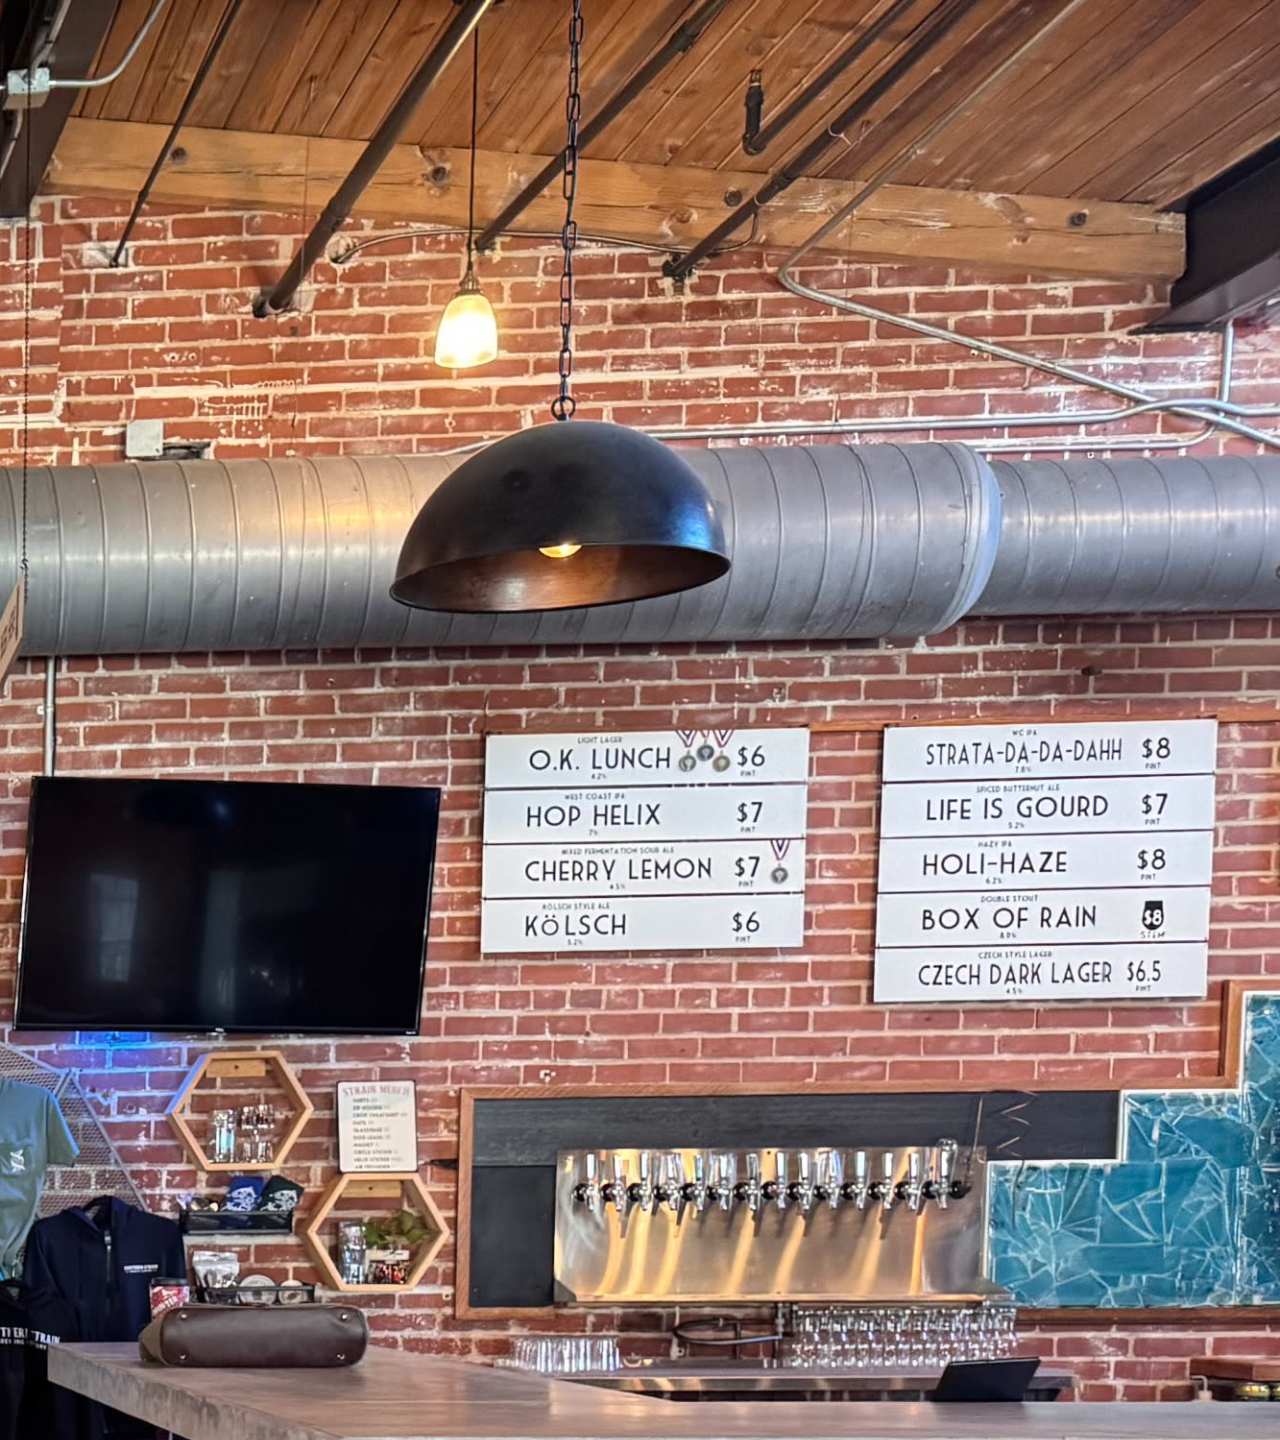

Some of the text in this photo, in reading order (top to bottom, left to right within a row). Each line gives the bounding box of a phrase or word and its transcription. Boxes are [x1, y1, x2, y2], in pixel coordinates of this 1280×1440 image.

[600, 736, 622, 744] LAGER
[1142, 737, 1171, 759] $8
[529, 748, 671, 770] O.K. LUNCH
[738, 745, 765, 767] $6
[926, 738, 1122, 765] STRATA-DA-DA-DAHH
[1048, 784, 1060, 792] ALE
[526, 804, 660, 827] HOP HELIX
[736, 802, 763, 823] $7
[926, 796, 1109, 821] LIFE IS GOURD
[1141, 794, 1168, 816] $7
[640, 846, 659, 854] SOUR
[1001, 840, 1012, 848] IPA
[525, 858, 712, 882] CHERRY LEMON
[734, 856, 760, 878] $7
[923, 851, 1067, 876] HOLI-HAZE
[1137, 848, 1166, 870] $8
[1013, 894, 1038, 902] STOUT
[525, 914, 626, 937] KÖLSCH
[732, 912, 760, 934] $6
[922, 905, 1096, 930] BOX OF RAIN
[978, 952, 1002, 960] CZECH
[1029, 950, 1052, 958] LAGER
[918, 961, 1112, 986] CZECH DARK LAGER
[1127, 960, 1161, 983] $6.5
[30, 1330, 60, 1345] TRAIN
